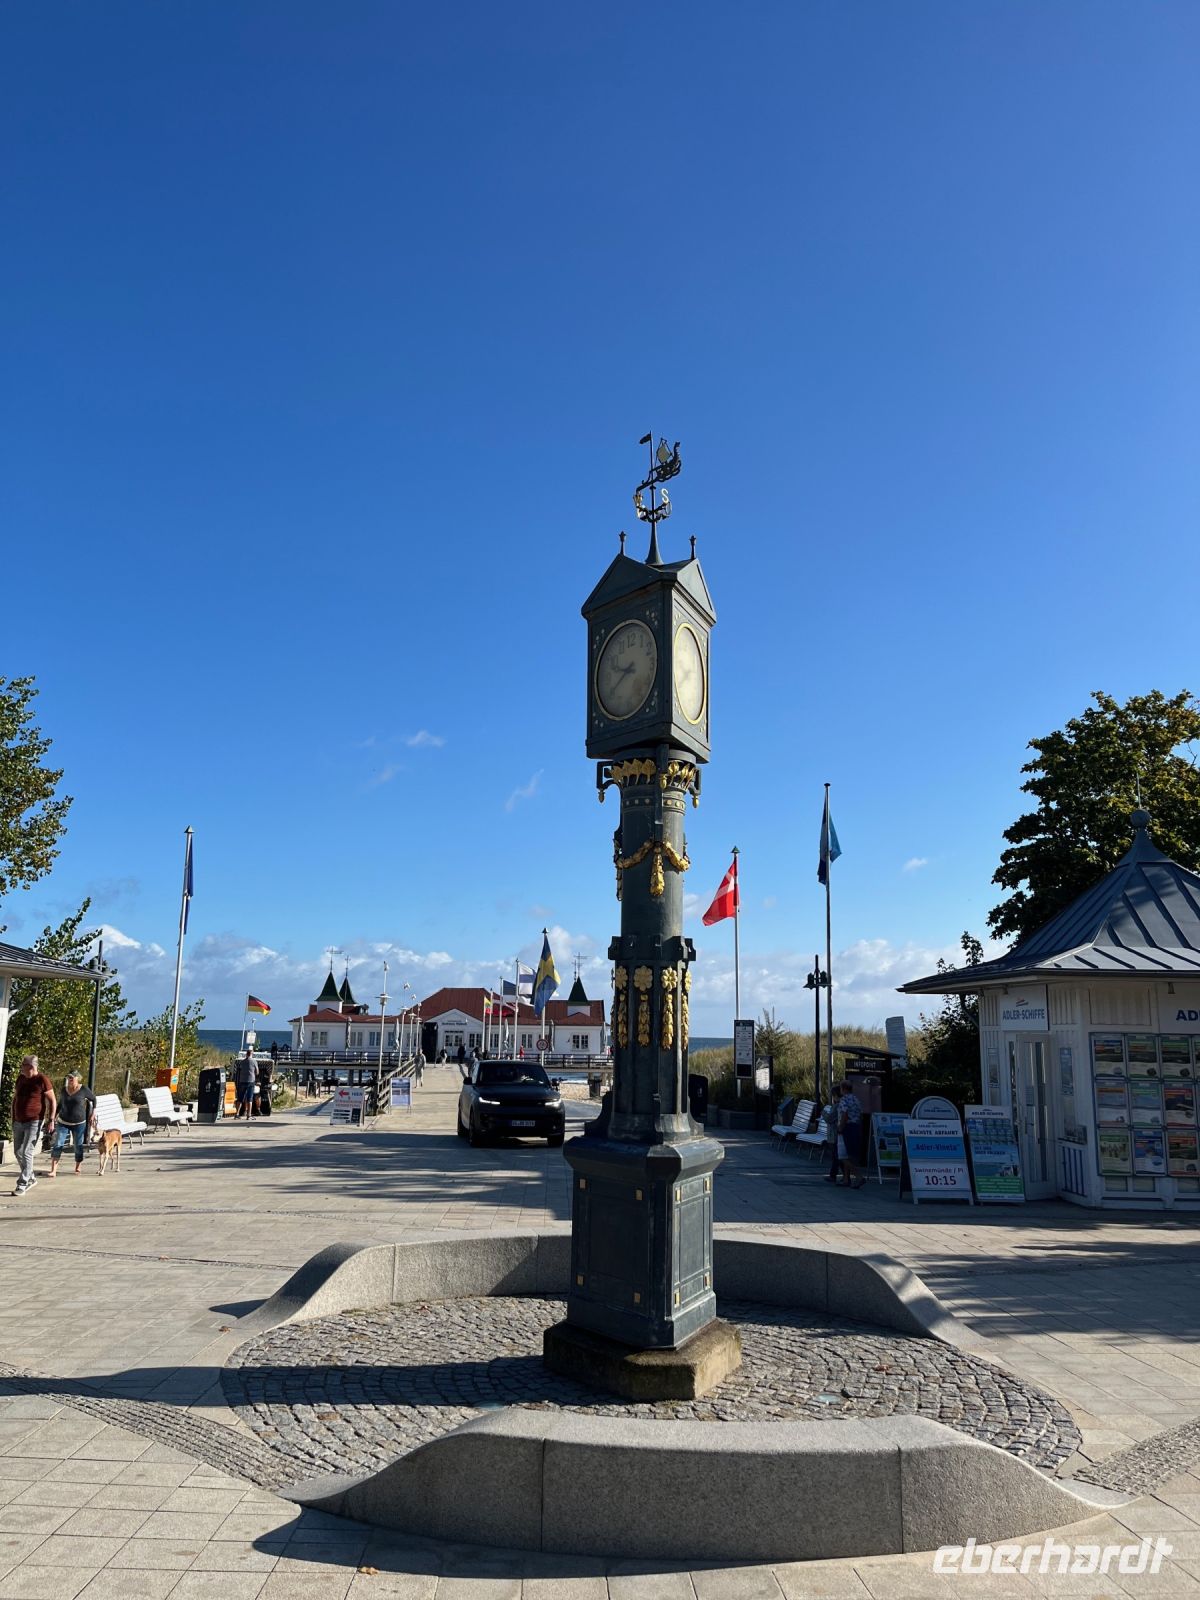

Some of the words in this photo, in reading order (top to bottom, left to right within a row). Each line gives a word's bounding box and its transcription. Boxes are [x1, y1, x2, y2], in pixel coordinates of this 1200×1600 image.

[661, 488, 669, 504] S
[627, 633, 636, 649] 12
[1002, 1009, 1046, 1020] ADLER-SCHIFFE
[1175, 1009, 1200, 1021] AD
[925, 1175, 957, 1186] 10:15
